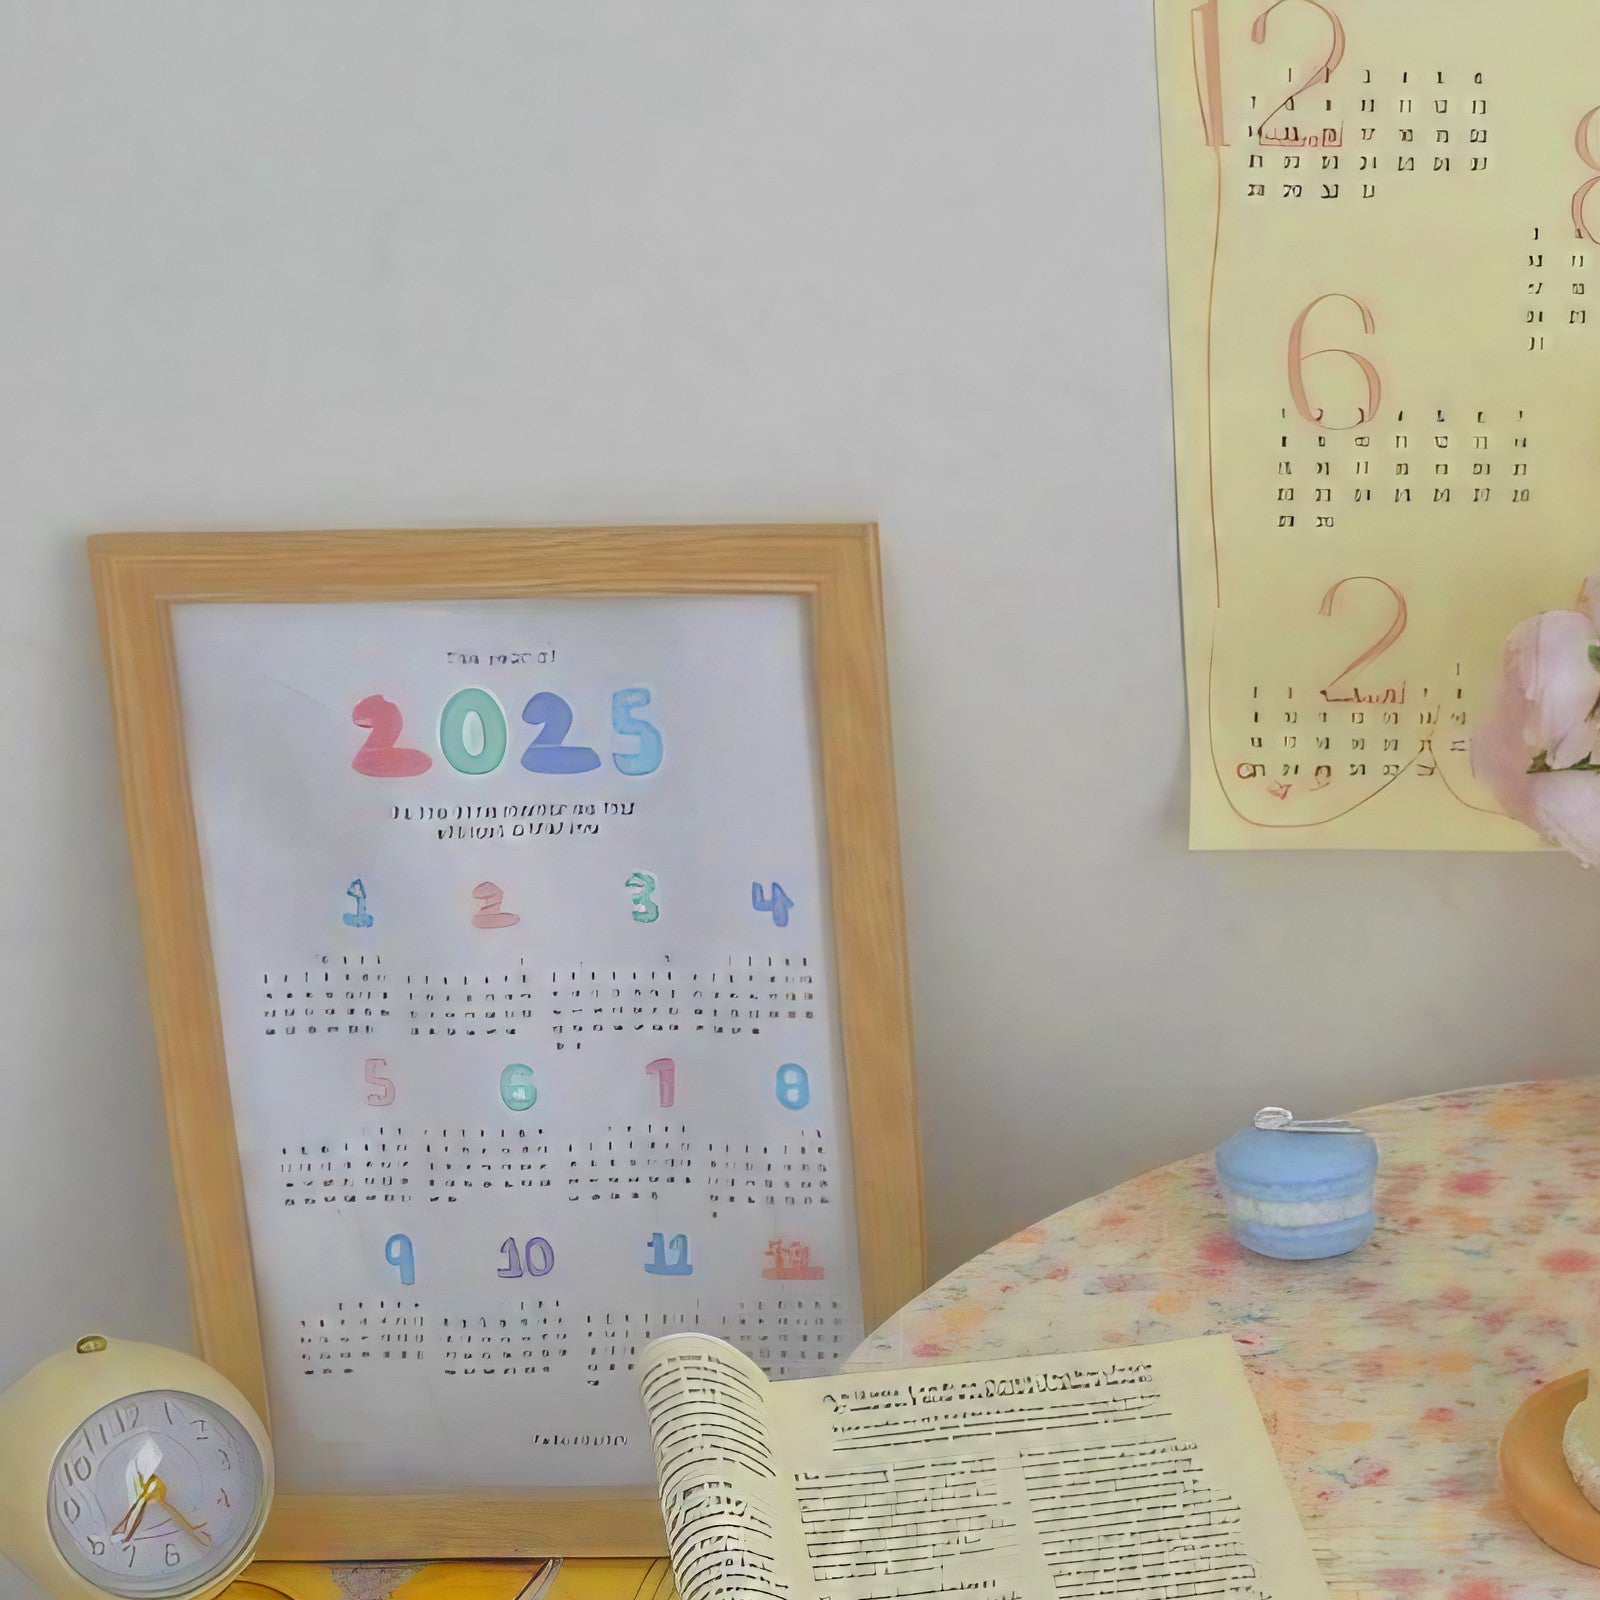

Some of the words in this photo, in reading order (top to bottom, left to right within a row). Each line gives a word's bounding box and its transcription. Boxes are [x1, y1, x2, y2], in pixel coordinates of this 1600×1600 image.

[1287, 293, 1381, 430] 6
[1316, 576, 1408, 704] 2
[351, 687, 664, 778] 2025
[343, 878, 374, 928] 1
[471, 881, 520, 929] 2
[625, 872, 660, 923] 3
[752, 881, 795, 927] 4
[364, 1058, 396, 1106] 5
[500, 1062, 538, 1111] 6
[776, 1062, 810, 1111] 8
[385, 1233, 416, 1285] 9
[497, 1236, 555, 1278] 10
